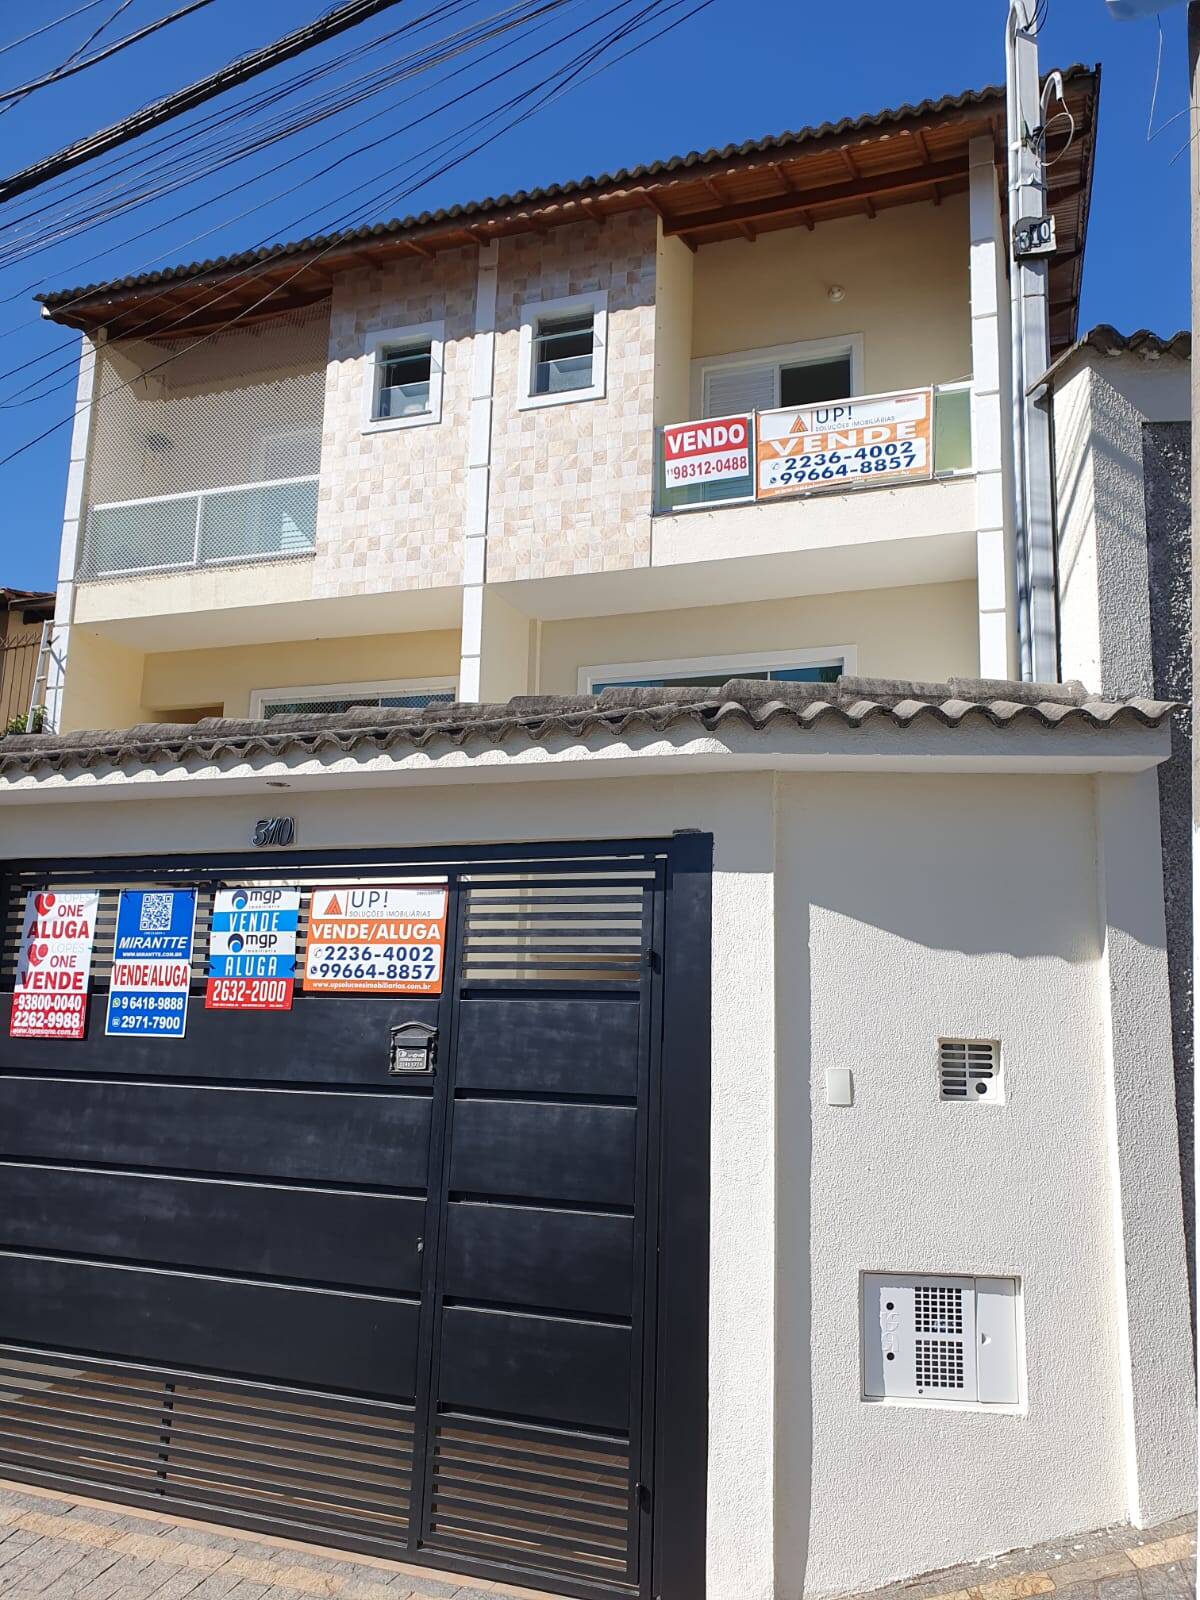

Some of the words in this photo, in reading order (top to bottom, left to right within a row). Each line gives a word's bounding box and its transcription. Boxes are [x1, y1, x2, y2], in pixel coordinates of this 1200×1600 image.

[1019, 222, 1050, 250] 310
[816, 405, 852, 424] UP!
[668, 424, 745, 454] VENDO
[769, 421, 917, 457] VENDE
[785, 441, 914, 471] 2236-4002
[674, 456, 747, 479] 98312-0488
[780, 455, 916, 485] 99664-8857
[252, 817, 294, 847] 310
[250, 890, 282, 904] mgp
[351, 890, 389, 908] UP!
[58, 905, 84, 917] ONE
[349, 909, 384, 918] SOLUÇÕES
[386, 910, 431, 918] IMOBILIÁRIAS
[27, 921, 90, 938] ALUGA
[229, 912, 280, 931] VENDE
[312, 923, 441, 941] VENDE/ALUGA
[118, 936, 188, 949] MIRANTTE
[245, 934, 278, 949] mgp
[51, 955, 77, 968] ONE
[324, 946, 434, 962] 2236-4002
[113, 965, 188, 986] VENDE/ALUGA
[225, 957, 277, 976] ALUGA
[320, 963, 436, 980] 99664-8857
[21, 972, 84, 989] VENDE
[213, 980, 287, 1002] 2632-2000
[18, 994, 82, 1011] 93800-0040
[14, 1011, 80, 1028] 2262-9988
[121, 1016, 180, 1029] 2971-7900
